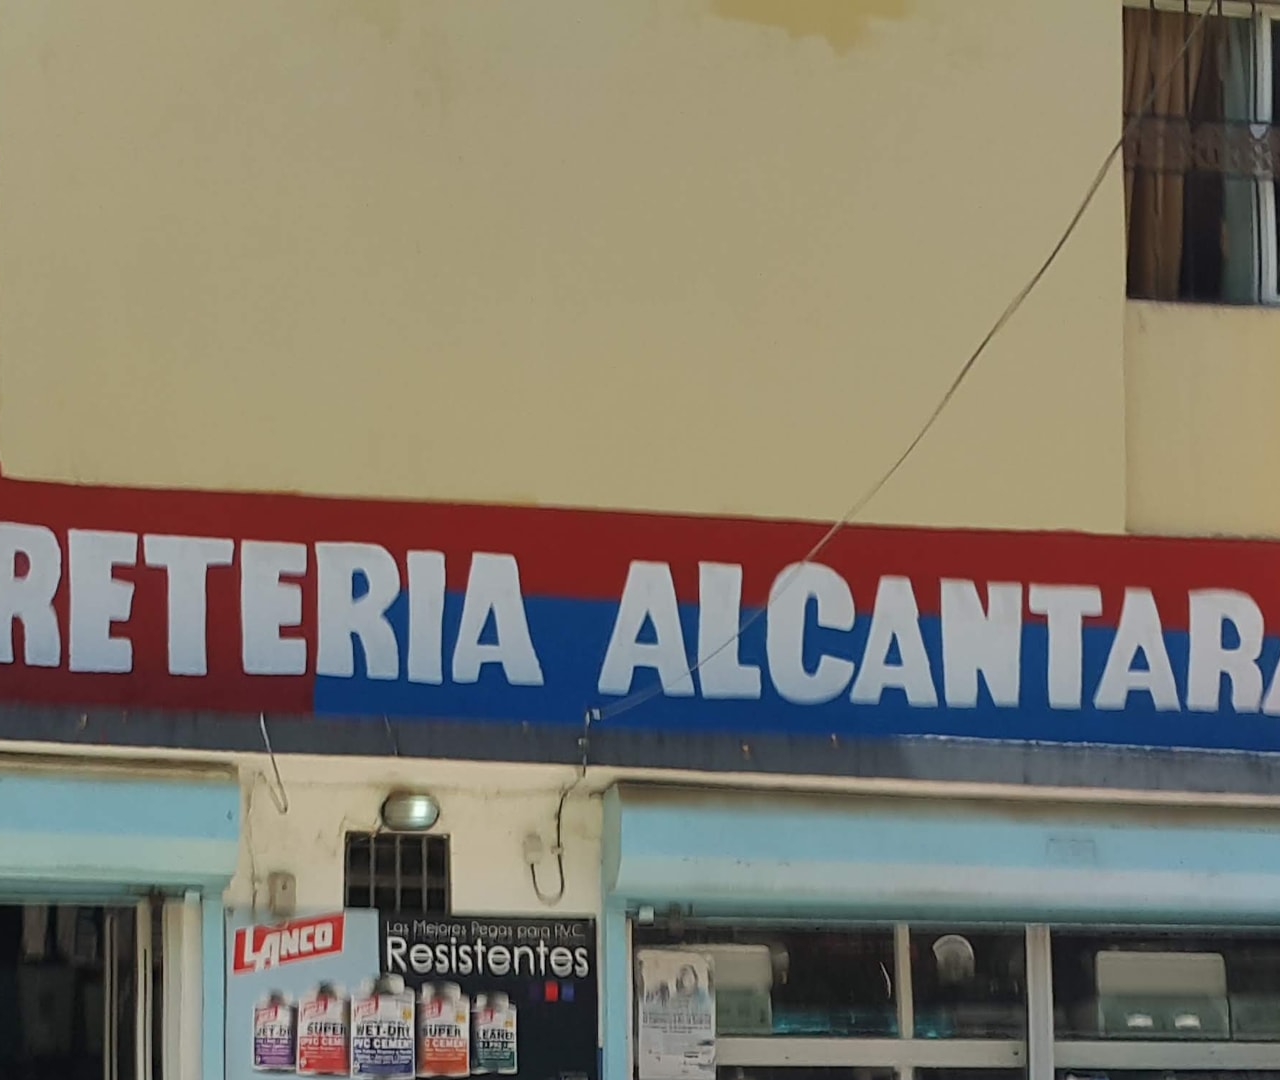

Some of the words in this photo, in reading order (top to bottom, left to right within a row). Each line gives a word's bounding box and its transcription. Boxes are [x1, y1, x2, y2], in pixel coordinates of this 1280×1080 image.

[243, 921, 333, 972] LANCO
[386, 920, 410, 937] Las
[413, 919, 467, 938] Mejores
[471, 920, 513, 940] Pegas
[517, 926, 551, 942] para
[386, 936, 590, 978] Resistentes
